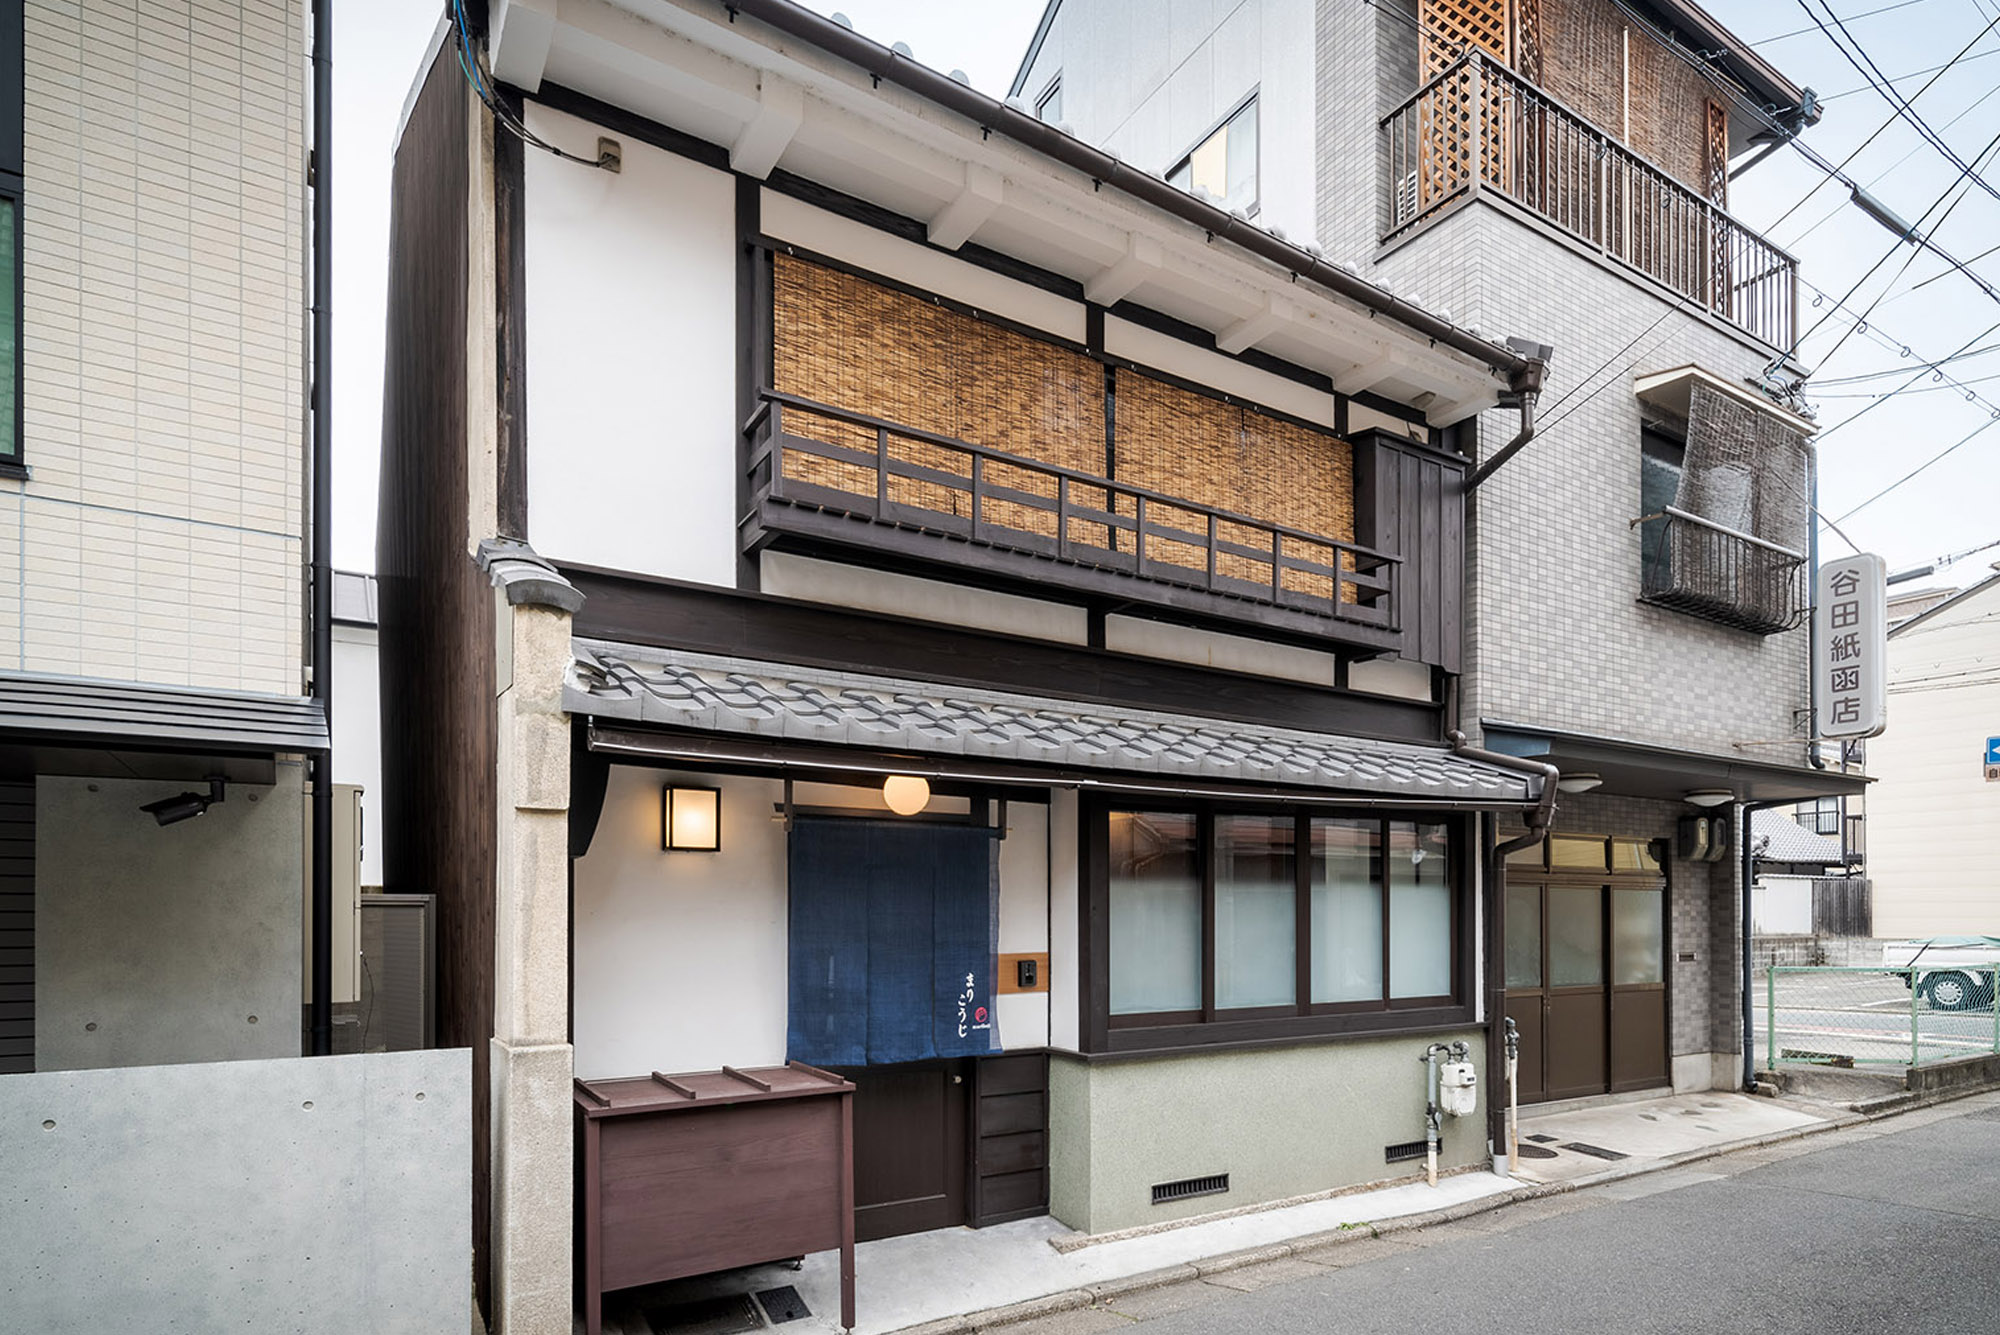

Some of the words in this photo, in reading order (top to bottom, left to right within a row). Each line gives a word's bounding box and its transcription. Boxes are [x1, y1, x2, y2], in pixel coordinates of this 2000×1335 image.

[1830, 569, 1861, 725] 谷田紙函店
